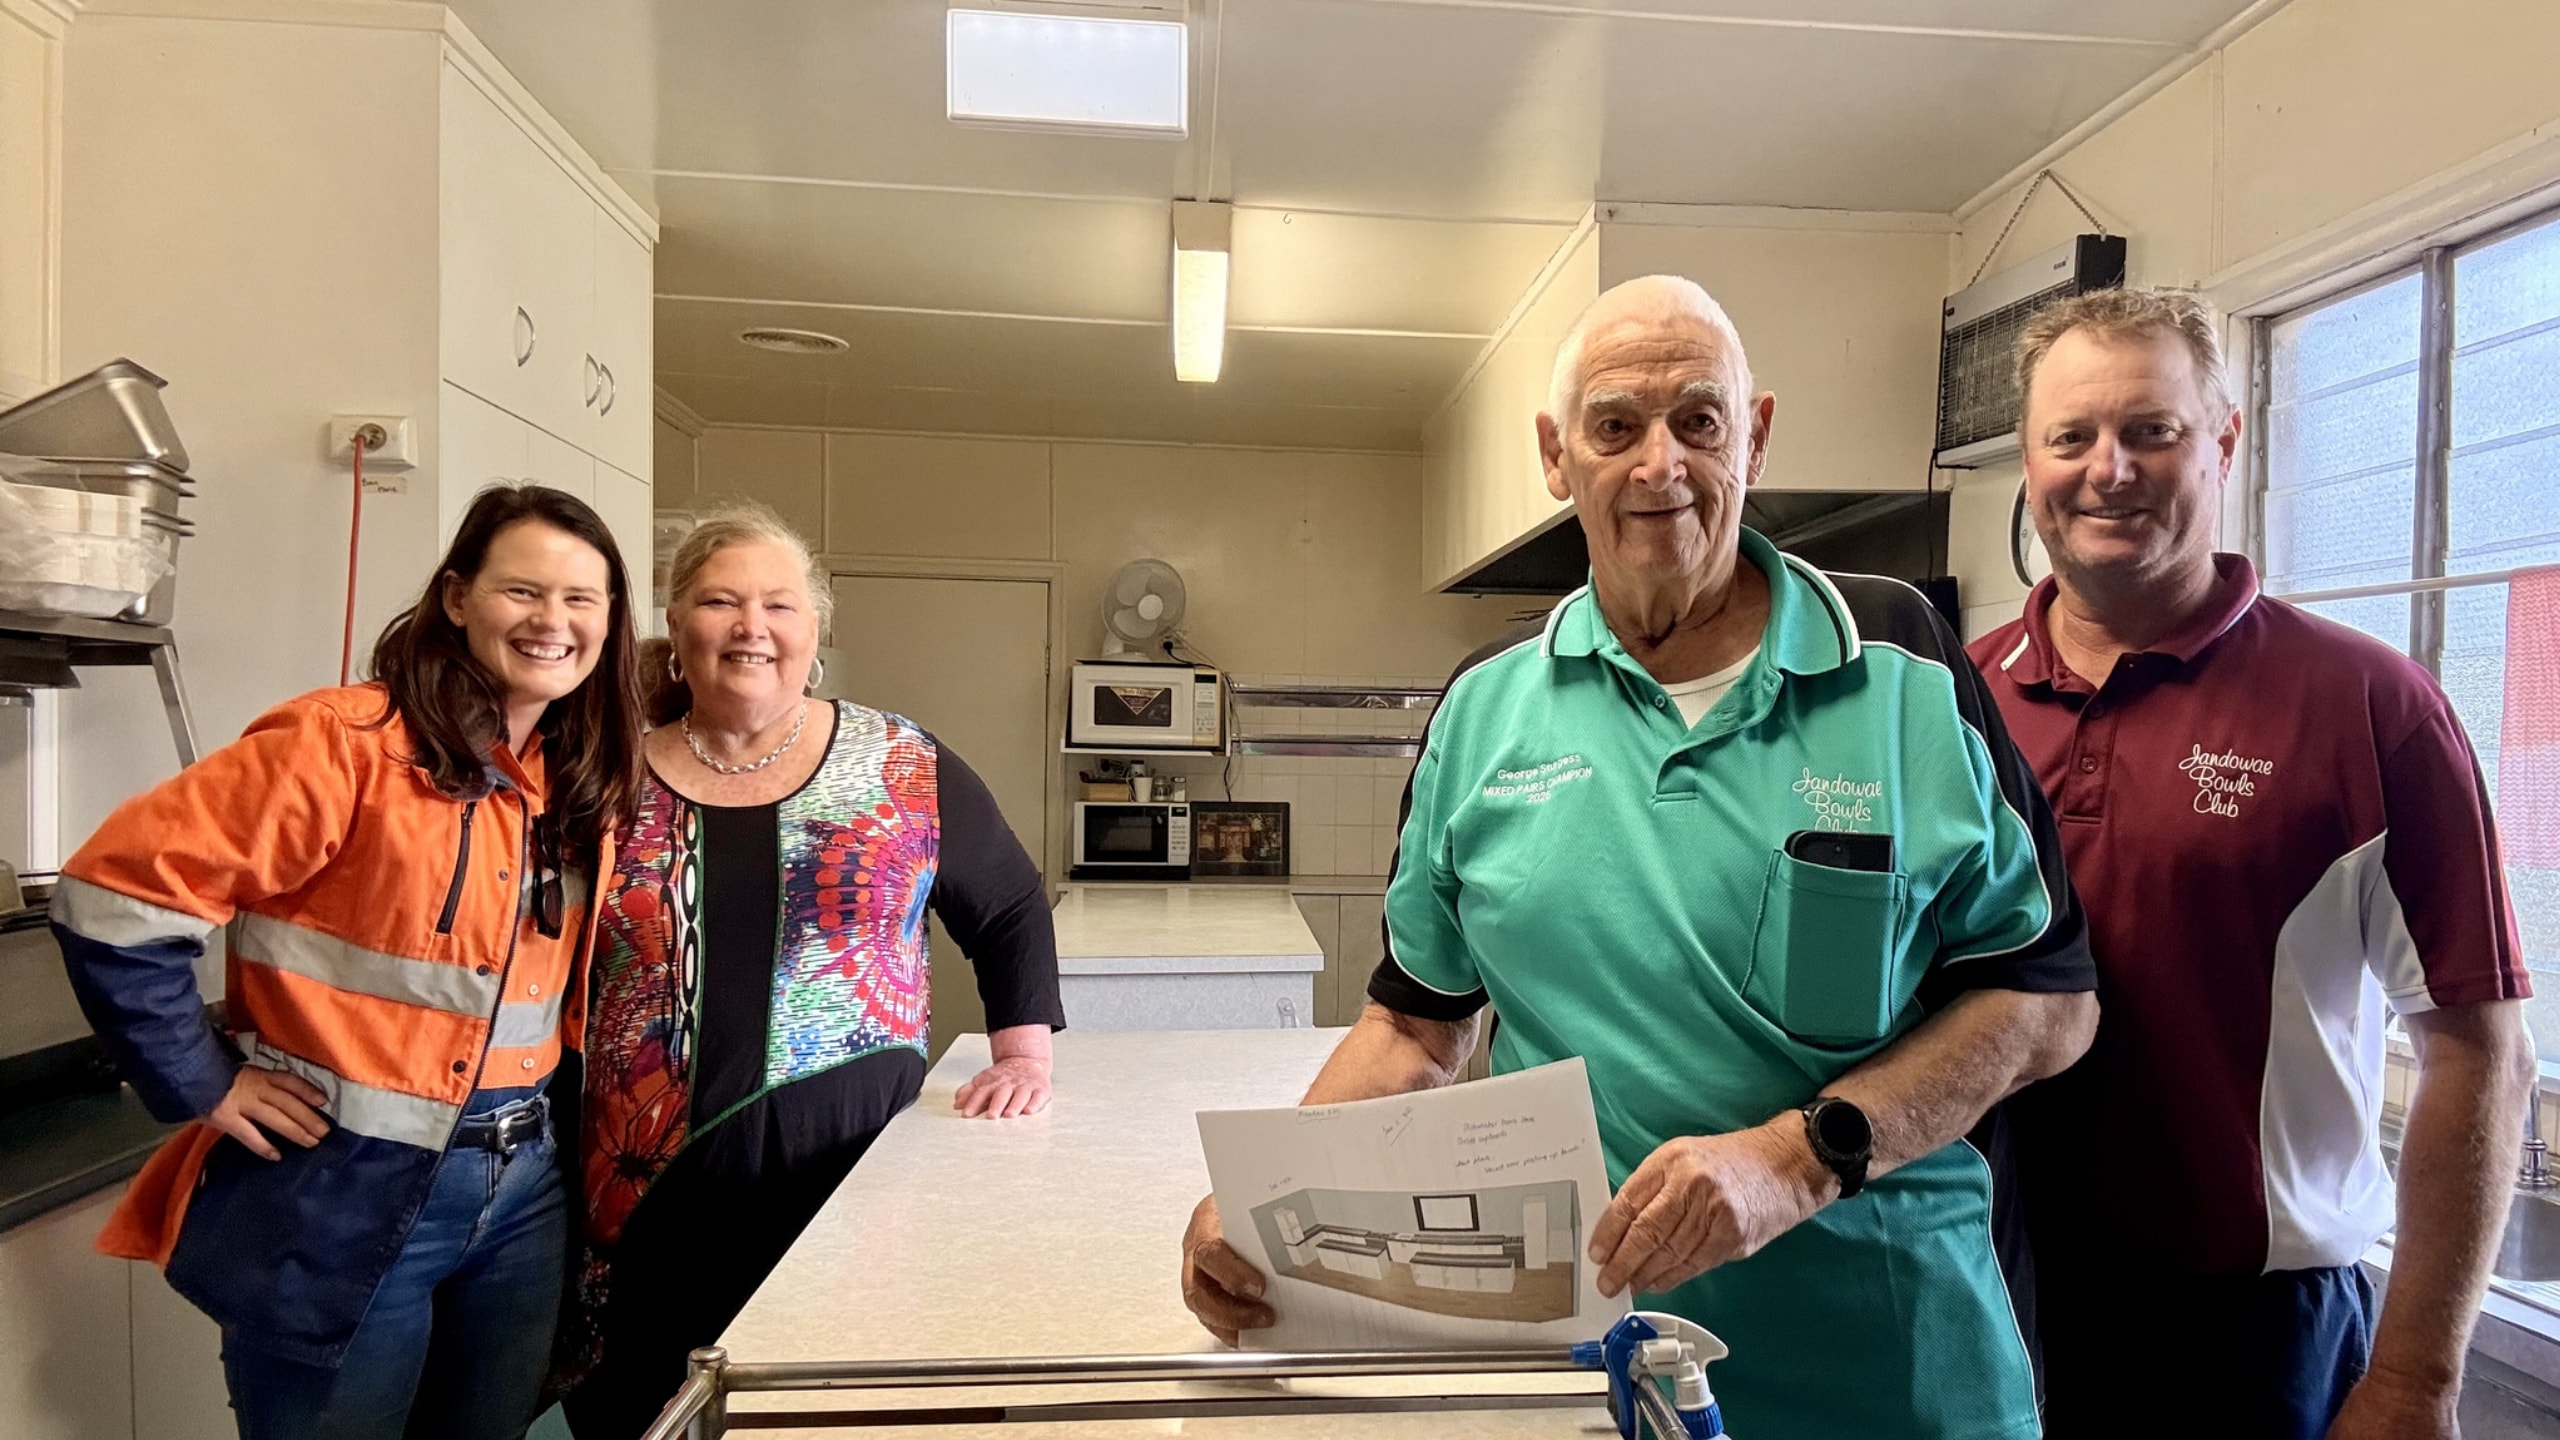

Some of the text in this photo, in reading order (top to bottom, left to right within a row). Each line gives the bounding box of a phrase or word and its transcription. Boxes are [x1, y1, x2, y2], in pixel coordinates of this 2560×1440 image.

[1497, 754, 1582, 780] George Sturgess
[2178, 743, 2273, 775] Jandowae
[1483, 766, 1593, 797] MIXED PAIRS CHAMPION
[1792, 767, 1882, 797] Jandowae
[2188, 765, 2255, 796] Bowls
[1527, 790, 1551, 804] 2025
[1804, 791, 1872, 821] Bowls
[2193, 788, 2239, 818] Club
